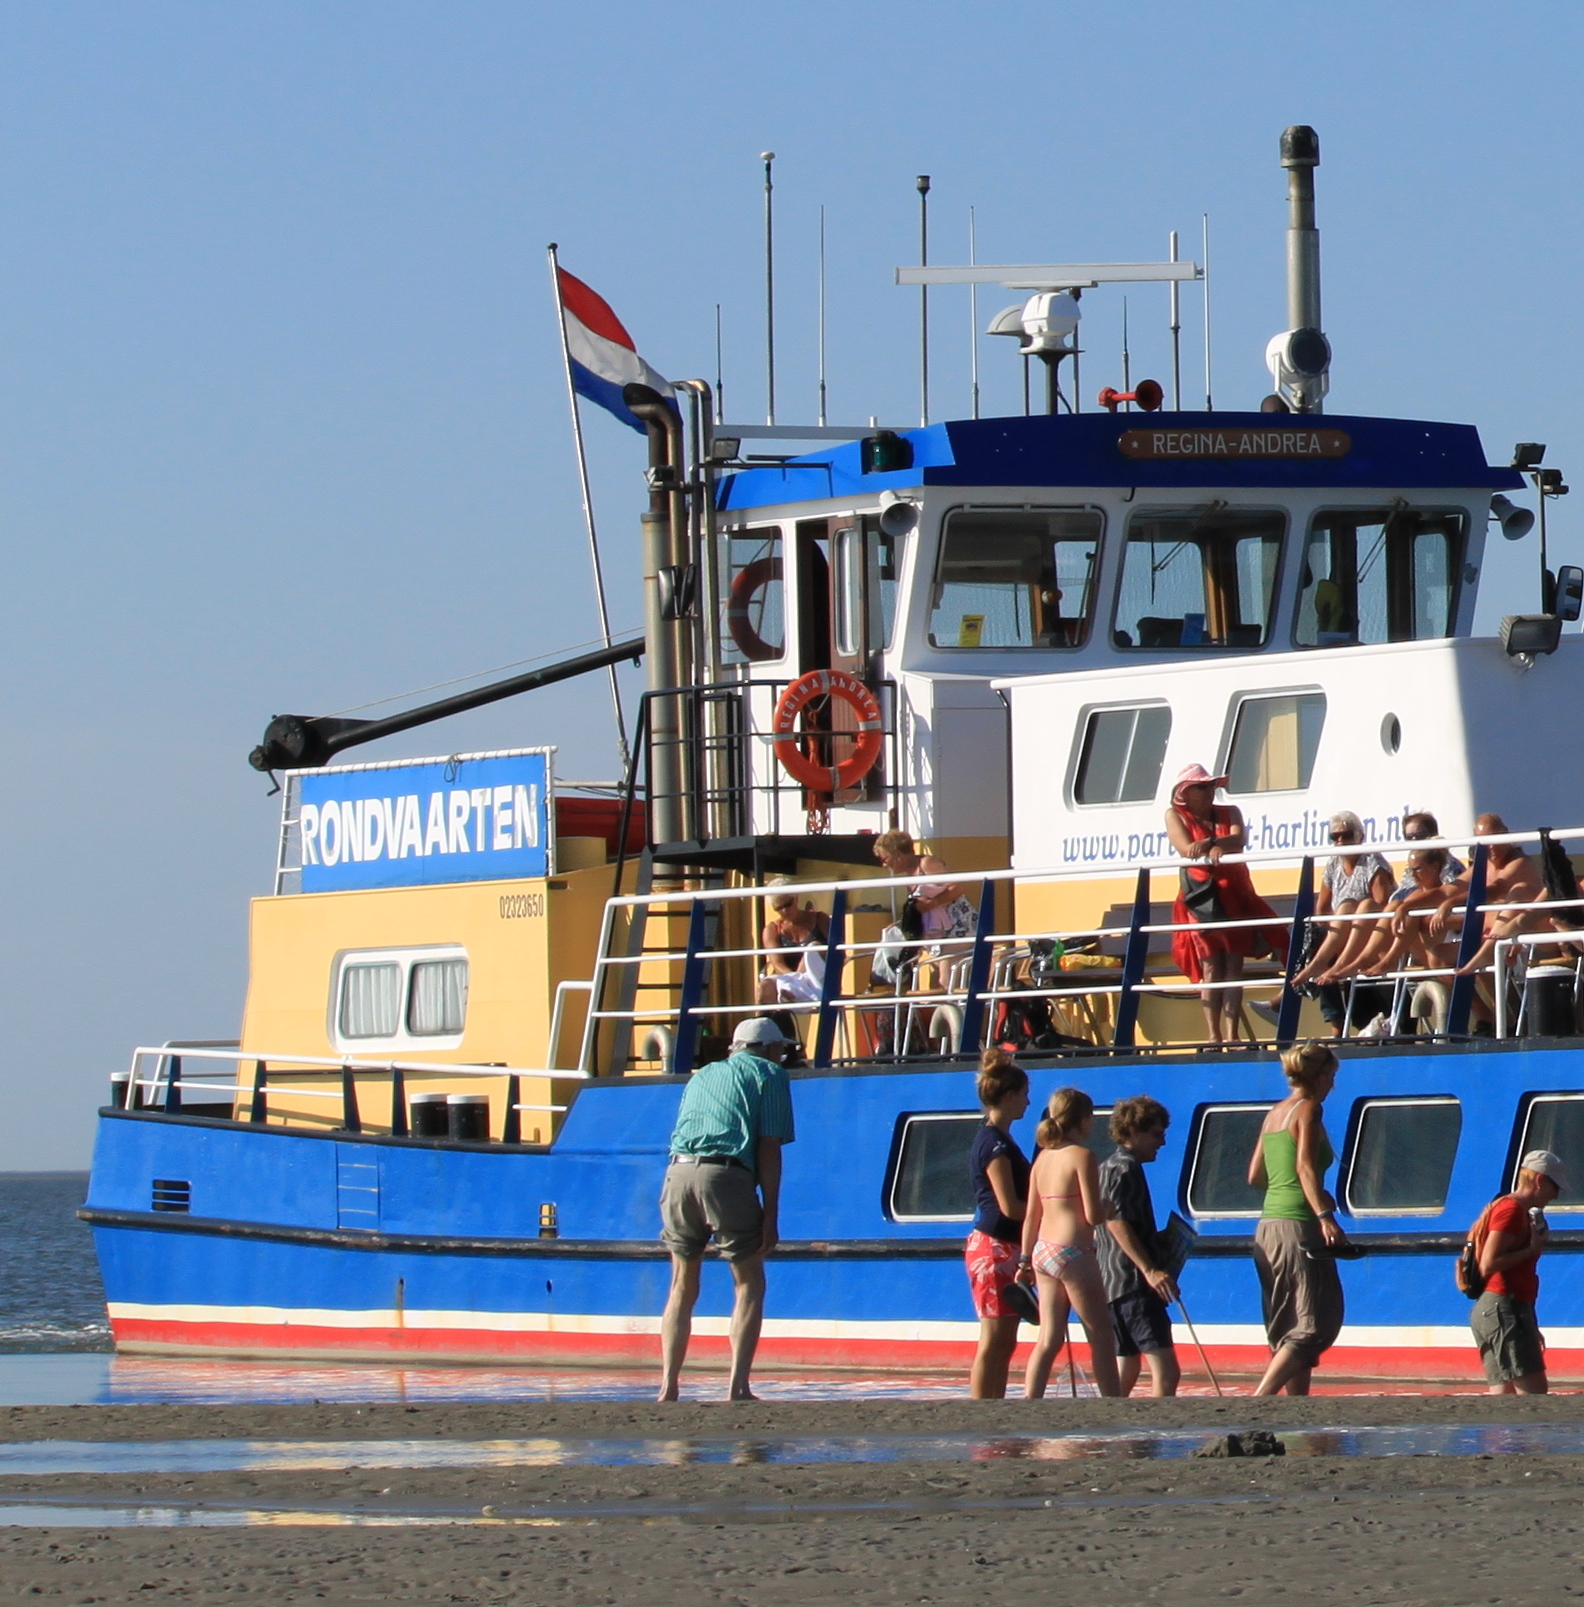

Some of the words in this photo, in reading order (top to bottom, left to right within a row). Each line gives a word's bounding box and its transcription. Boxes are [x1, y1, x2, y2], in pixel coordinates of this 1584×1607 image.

[1152, 433, 1322, 454] REGINA-ANDREA
[301, 784, 539, 867] RONDVAARTEN
[500, 893, 544, 919] 02323650
